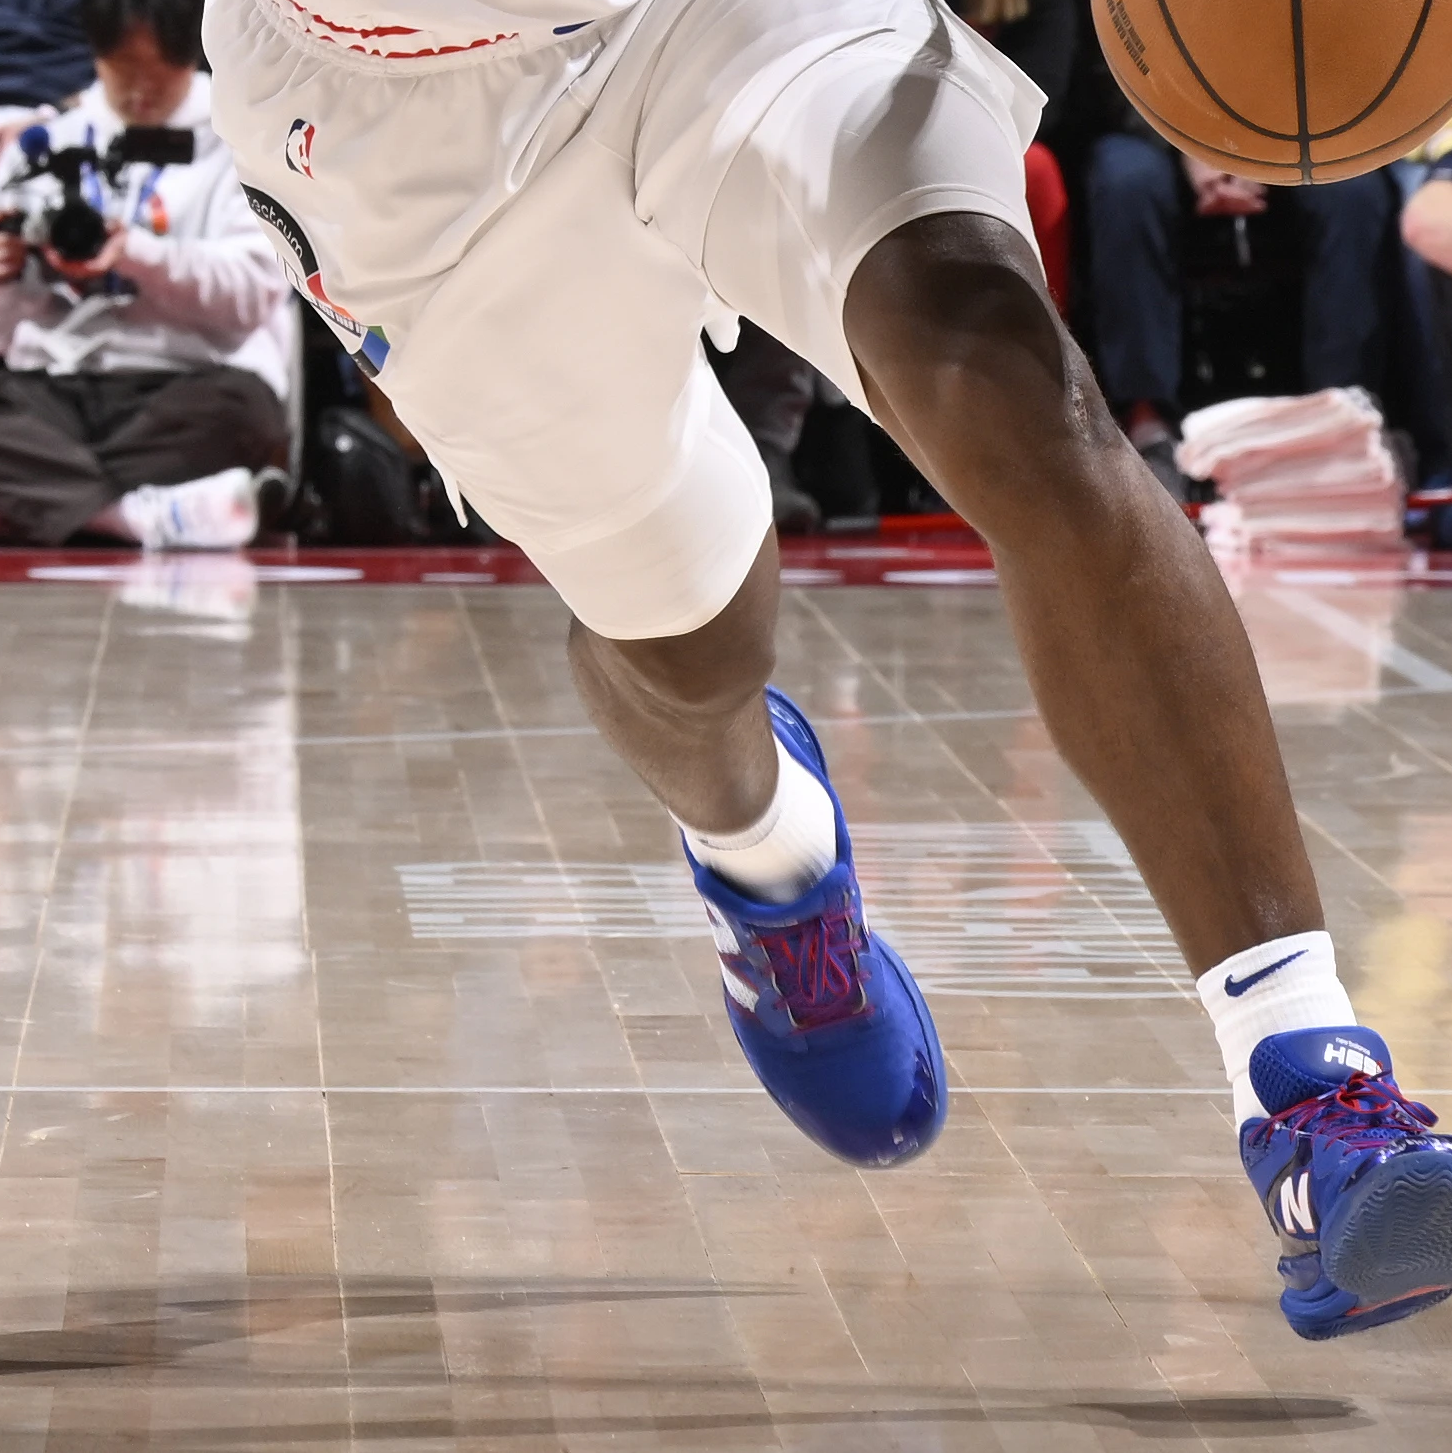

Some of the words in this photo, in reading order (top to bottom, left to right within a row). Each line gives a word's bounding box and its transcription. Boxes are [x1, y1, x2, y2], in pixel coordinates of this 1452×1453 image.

[246, 195, 304, 260] ectrum
[1323, 1042, 1383, 1077] HES
[1280, 1170, 1316, 1234] N
